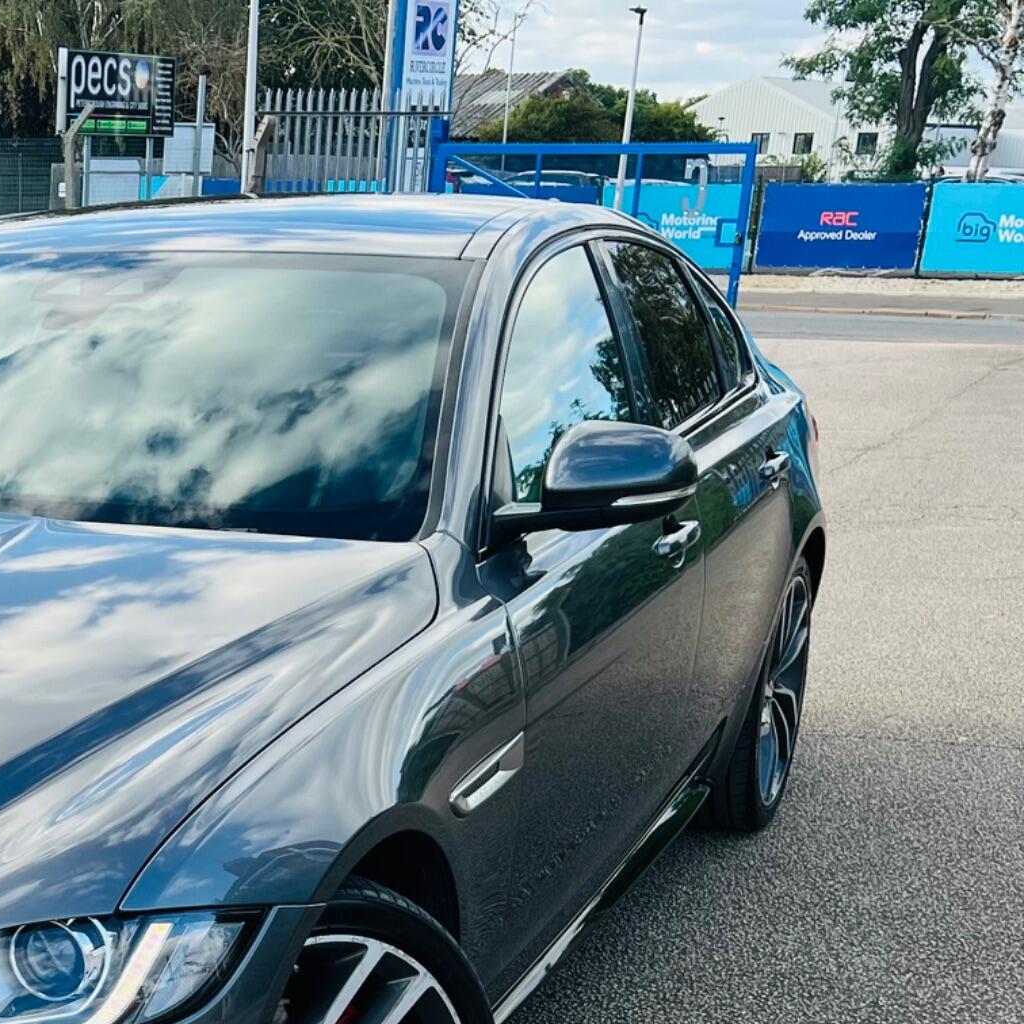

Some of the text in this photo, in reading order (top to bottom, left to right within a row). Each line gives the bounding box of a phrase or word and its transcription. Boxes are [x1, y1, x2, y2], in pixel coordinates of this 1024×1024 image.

[70, 55, 132, 109] pecs
[660, 227, 701, 239] World
[797, 230, 877, 242] Approved Dealer
[963, 221, 991, 242] big
